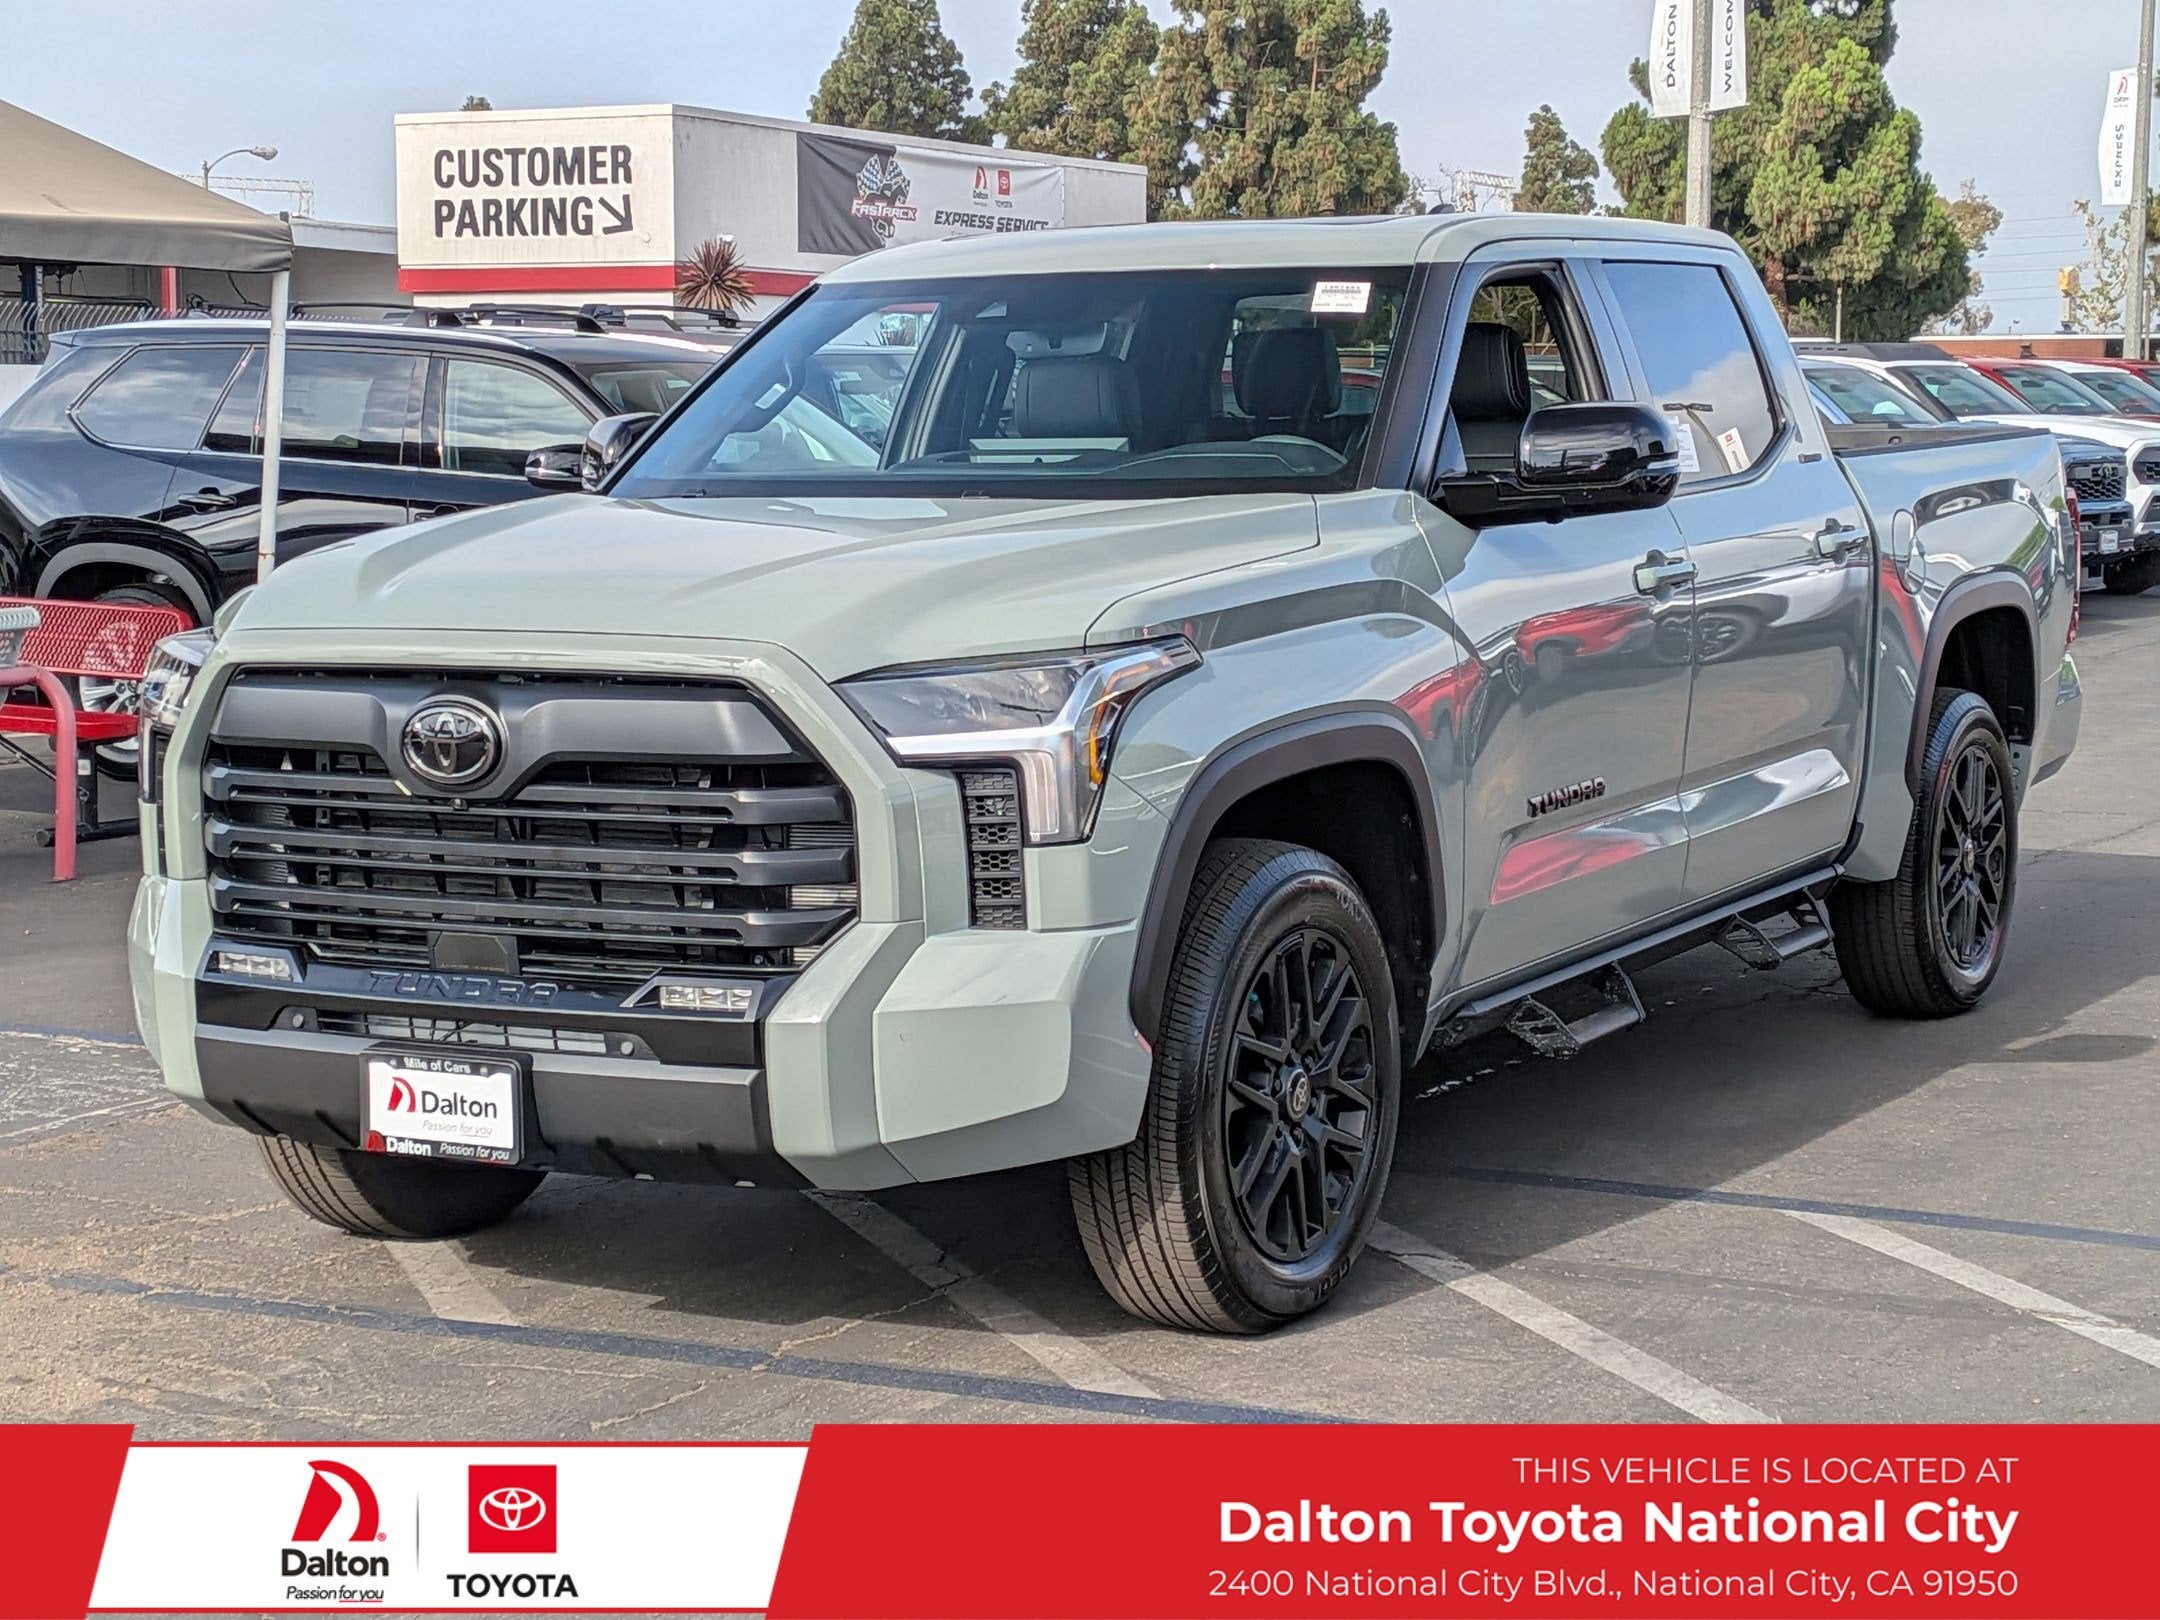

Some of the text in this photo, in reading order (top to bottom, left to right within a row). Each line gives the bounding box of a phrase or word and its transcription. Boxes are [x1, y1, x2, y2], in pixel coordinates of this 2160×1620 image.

[1667, 4, 1677, 88] DALTON
[433, 144, 633, 188] CUSTOMER
[2115, 124, 2124, 187] EXPRESS
[433, 196, 594, 238] PARKING
[933, 209, 1049, 232] EXPRESS SERVICE
[1526, 776, 1606, 818] TUNDRA
[369, 969, 560, 1006] TUNDRA
[403, 1056, 472, 1074] Mile of Cars
[421, 1090, 498, 1119] Dalton
[422, 1120, 493, 1136] Passion for you
[386, 1137, 432, 1156] Dalton
[439, 1142, 511, 1161] Passion for you
